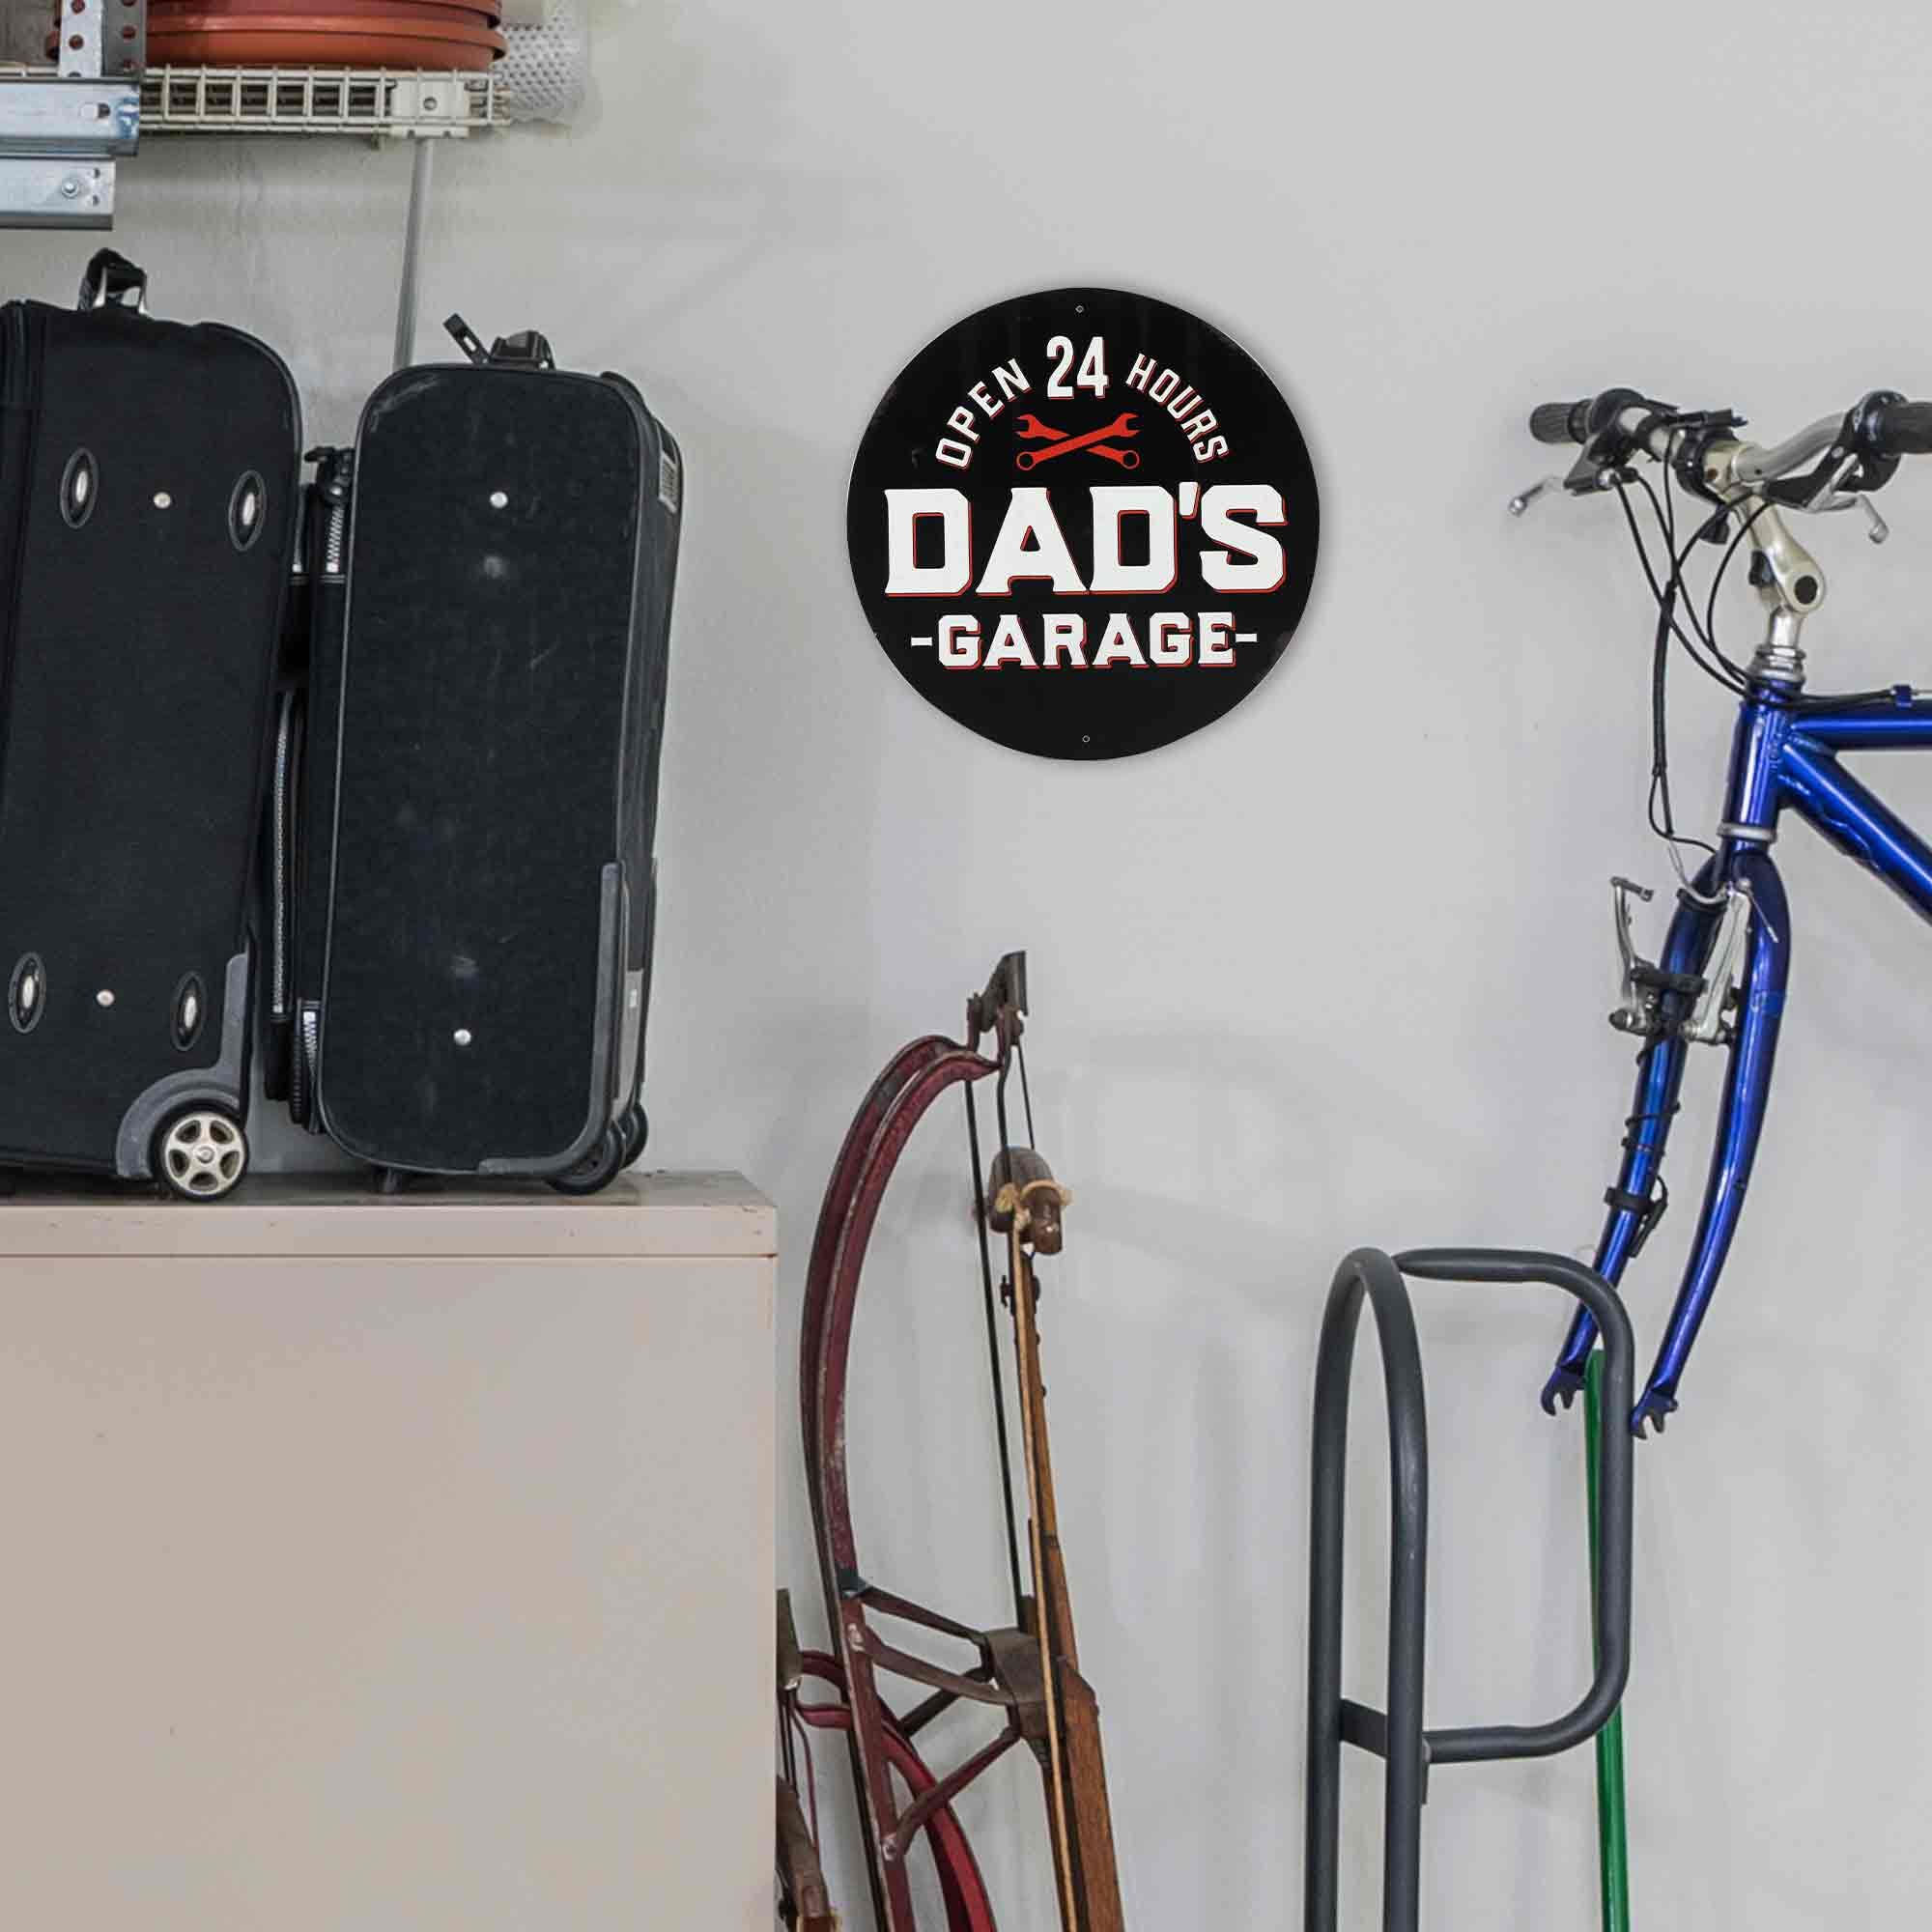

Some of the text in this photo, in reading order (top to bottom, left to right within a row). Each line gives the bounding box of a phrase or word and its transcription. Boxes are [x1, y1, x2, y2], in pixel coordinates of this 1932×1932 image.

[935, 335, 1230, 470] OPEN 24 HOURS
[884, 481, 1289, 597] DAD'S
